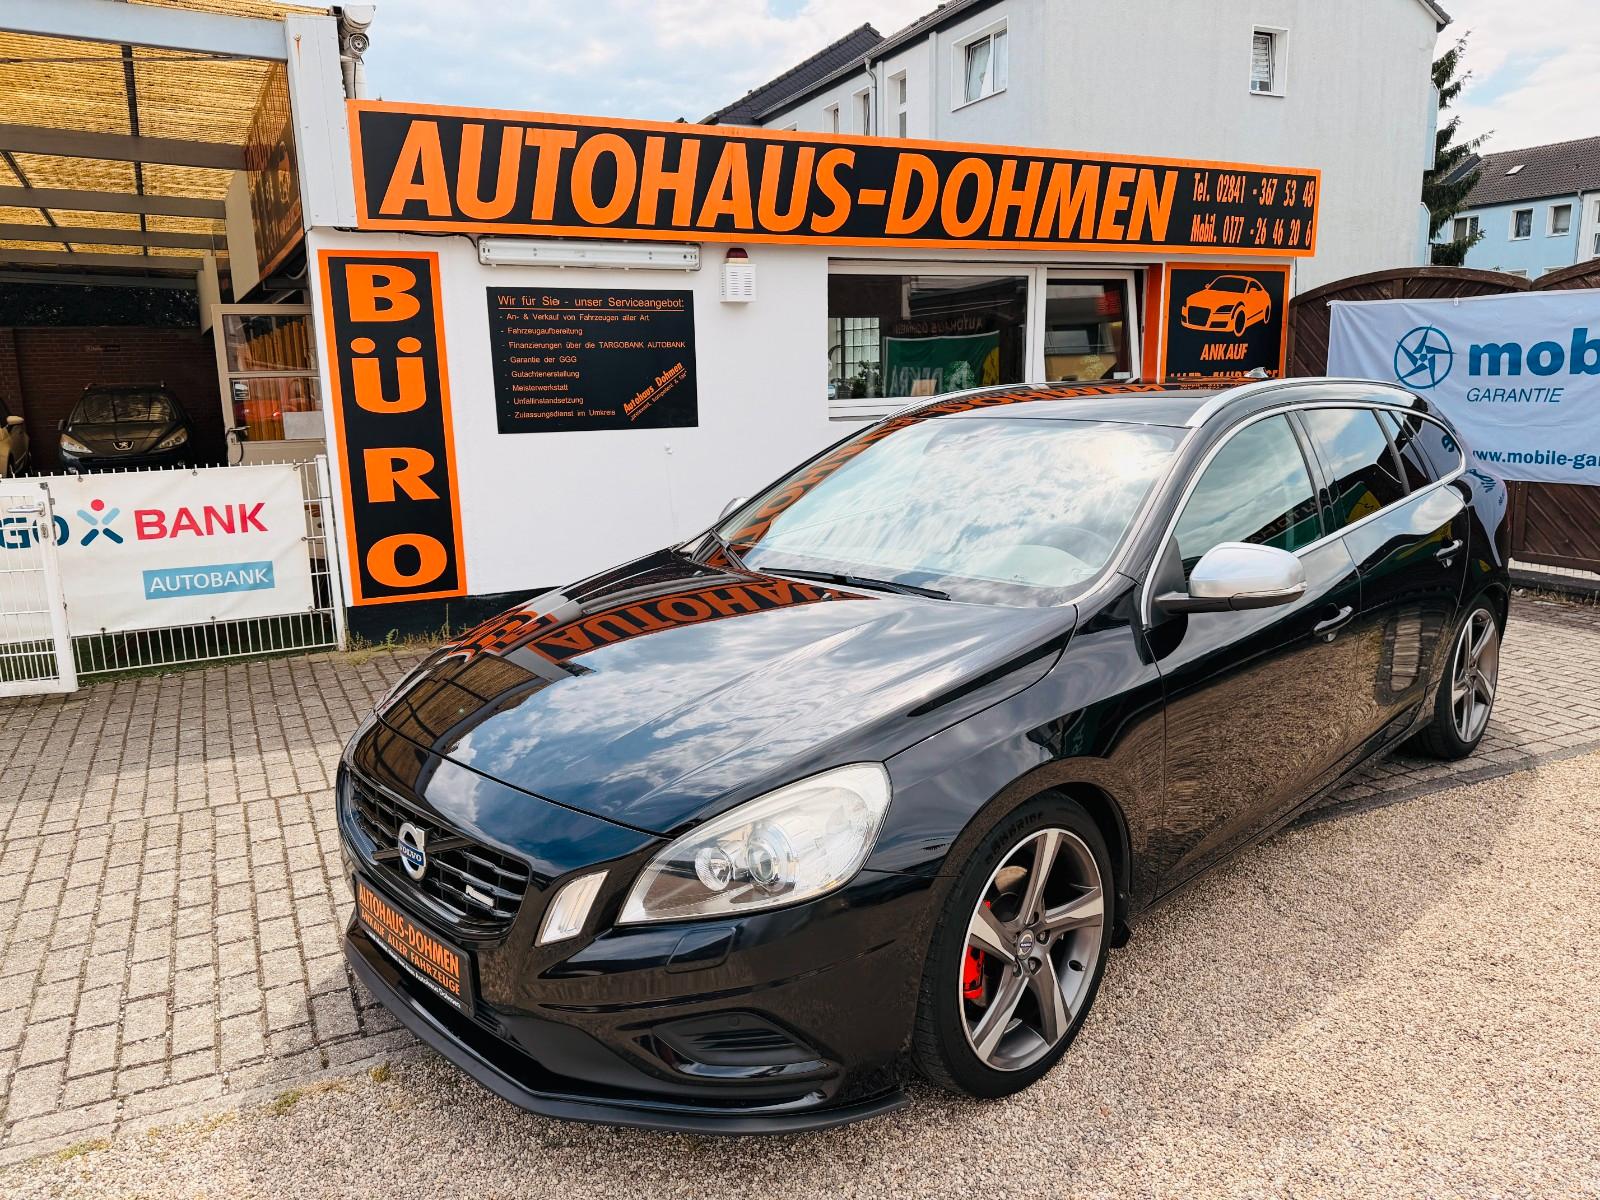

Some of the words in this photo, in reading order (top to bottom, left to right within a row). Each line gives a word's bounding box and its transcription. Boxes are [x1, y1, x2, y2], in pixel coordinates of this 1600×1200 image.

[379, 120, 1178, 242] AUTOHAUS-DOHMEN
[1193, 171, 1210, 202] Tel.
[1216, 173, 1246, 204] 02841
[1283, 179, 1297, 207] 53
[1302, 180, 1315, 208] 48
[1190, 213, 1217, 243] Mobil.
[1222, 215, 1245, 244] 0177
[1272, 218, 1284, 246] 46
[1287, 218, 1301, 246] 20
[1305, 220, 1312, 247] 6
[497, 295, 517, 306] Wir
[521, 295, 536, 306] für
[541, 295, 560, 306] Sie
[574, 297, 602, 307] unser
[608, 297, 684, 310] Serviceangebot:
[506, 313, 519, 321] An-
[523, 313, 529, 321] &
[532, 313, 560, 321] Verkauf
[579, 313, 619, 323] Fahrzeugen
[507, 327, 583, 336] Fahrzeugaufbereitung
[508, 341, 562, 350] Finanzierungen
[565, 341, 581, 349] über
[584, 341, 596, 349] die
[599, 341, 644, 349] TARGOBANK
[1200, 343, 1249, 361] ANKAUF
[559, 355, 577, 363] GGG
[511, 370, 580, 379] Gutachtenerstellung
[512, 384, 569, 392] Meisterwerkstatt
[623, 385, 655, 415] Autohaus
[655, 362, 683, 387] Dohmen
[1466, 387, 1564, 403] GARANTIE
[513, 397, 584, 405] Unfallinstandsetzung
[514, 410, 574, 419] Zulassungsdienst
[588, 409, 616, 417] Umkreis
[134, 502, 268, 541] BANK
[149, 567, 269, 593] AUTOBANK
[400, 845, 422, 862] VOLVO
[359, 883, 460, 979] AUTOHAUS-DOHMEN
[388, 932, 408, 959] ALLER
[410, 951, 460, 996] FAHRZEUGE
